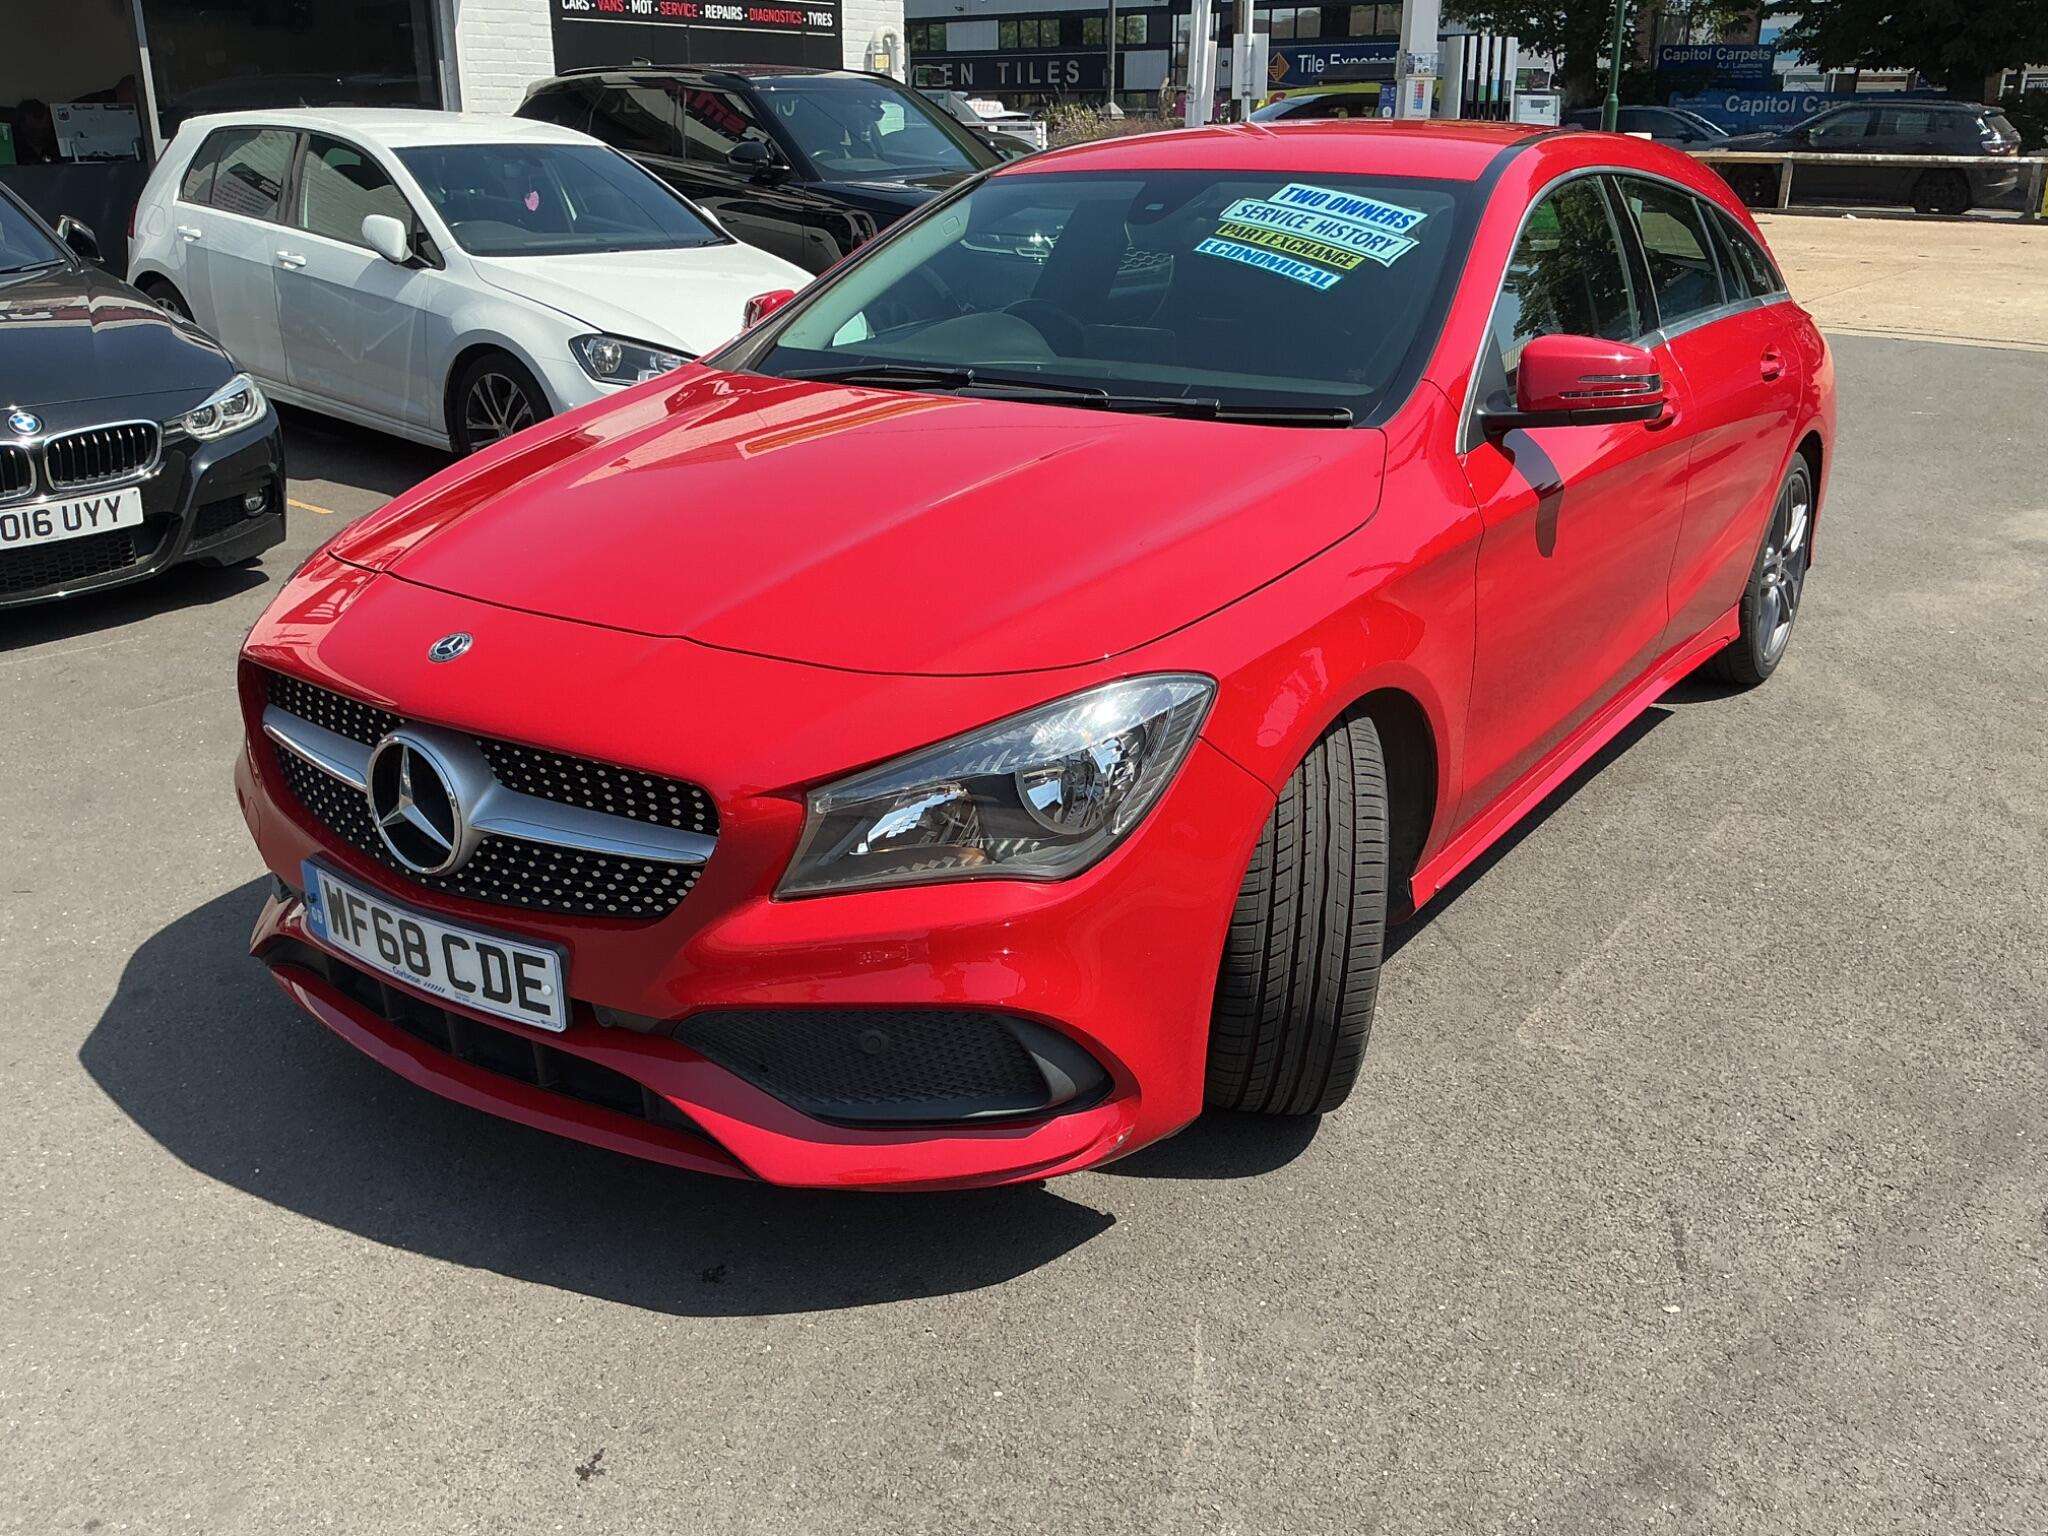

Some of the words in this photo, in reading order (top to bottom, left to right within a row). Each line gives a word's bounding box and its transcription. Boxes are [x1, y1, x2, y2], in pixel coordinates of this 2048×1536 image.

[597, 0, 625, 13] VANS
[631, 0, 652, 14] MOT
[660, 2, 698, 17] SERVICE
[705, 5, 743, 20] REPAIRS
[749, 8, 802, 24] DIAGNOSTICS
[808, 12, 833, 26] TYRES
[996, 60, 1079, 84] TILES
[1298, 54, 1324, 73] Tile
[1662, 48, 1712, 63] Capitol
[1716, 47, 1771, 62] Carpets
[1726, 96, 1796, 116] Capitol
[1279, 187, 1331, 206] TWO
[1325, 196, 1417, 229] OWNERS
[1220, 223, 1268, 242] PART
[1265, 232, 1357, 267] EXCHANGE
[1234, 204, 1315, 229] SERVICE
[1310, 219, 1399, 253] HISTORY
[1199, 240, 1335, 287] ECONOMICAL
[62, 495, 121, 531] UYY
[324, 880, 431, 977] WF68
[441, 933, 551, 1016] CDE
